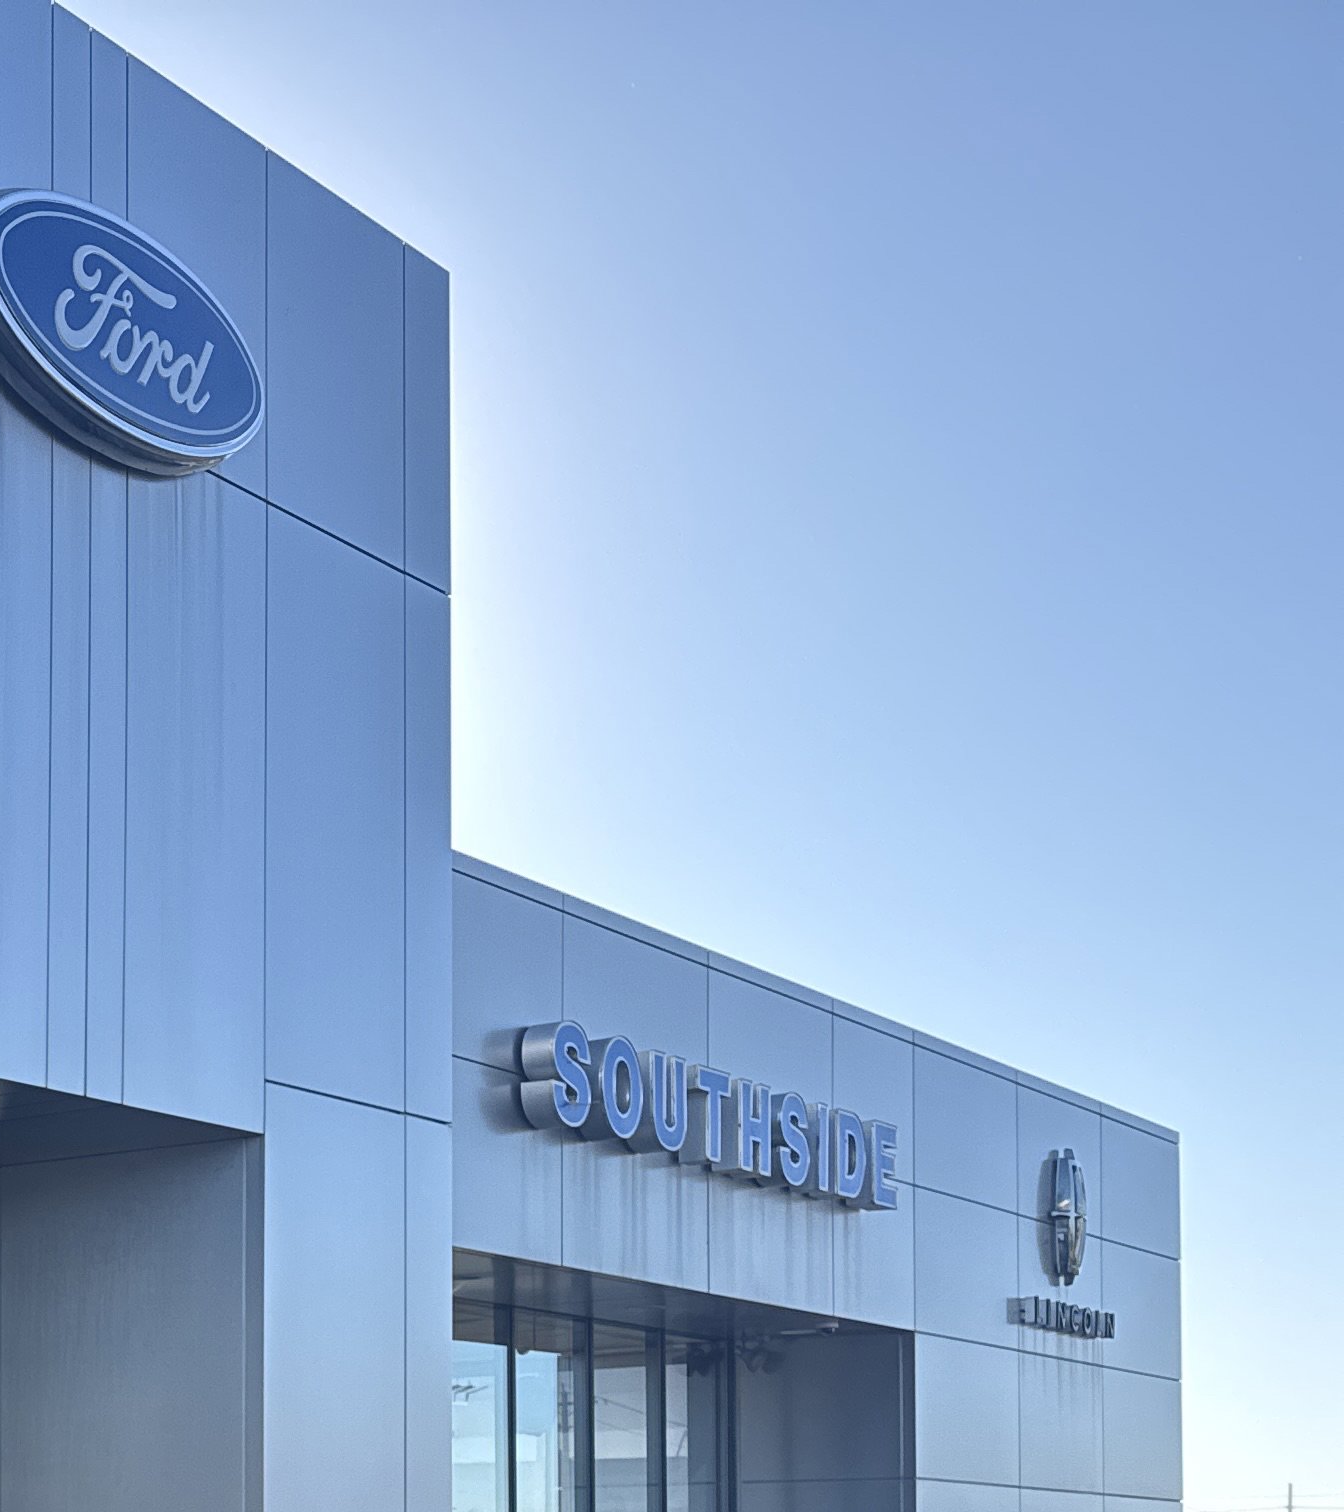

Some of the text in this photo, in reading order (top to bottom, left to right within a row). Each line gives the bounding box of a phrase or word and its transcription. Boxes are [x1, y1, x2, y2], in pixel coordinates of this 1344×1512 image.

[54, 244, 215, 414] Ford
[520, 1019, 899, 1211] SOUTHSIDE
[1020, 1295, 1115, 1339] LINCOLN
